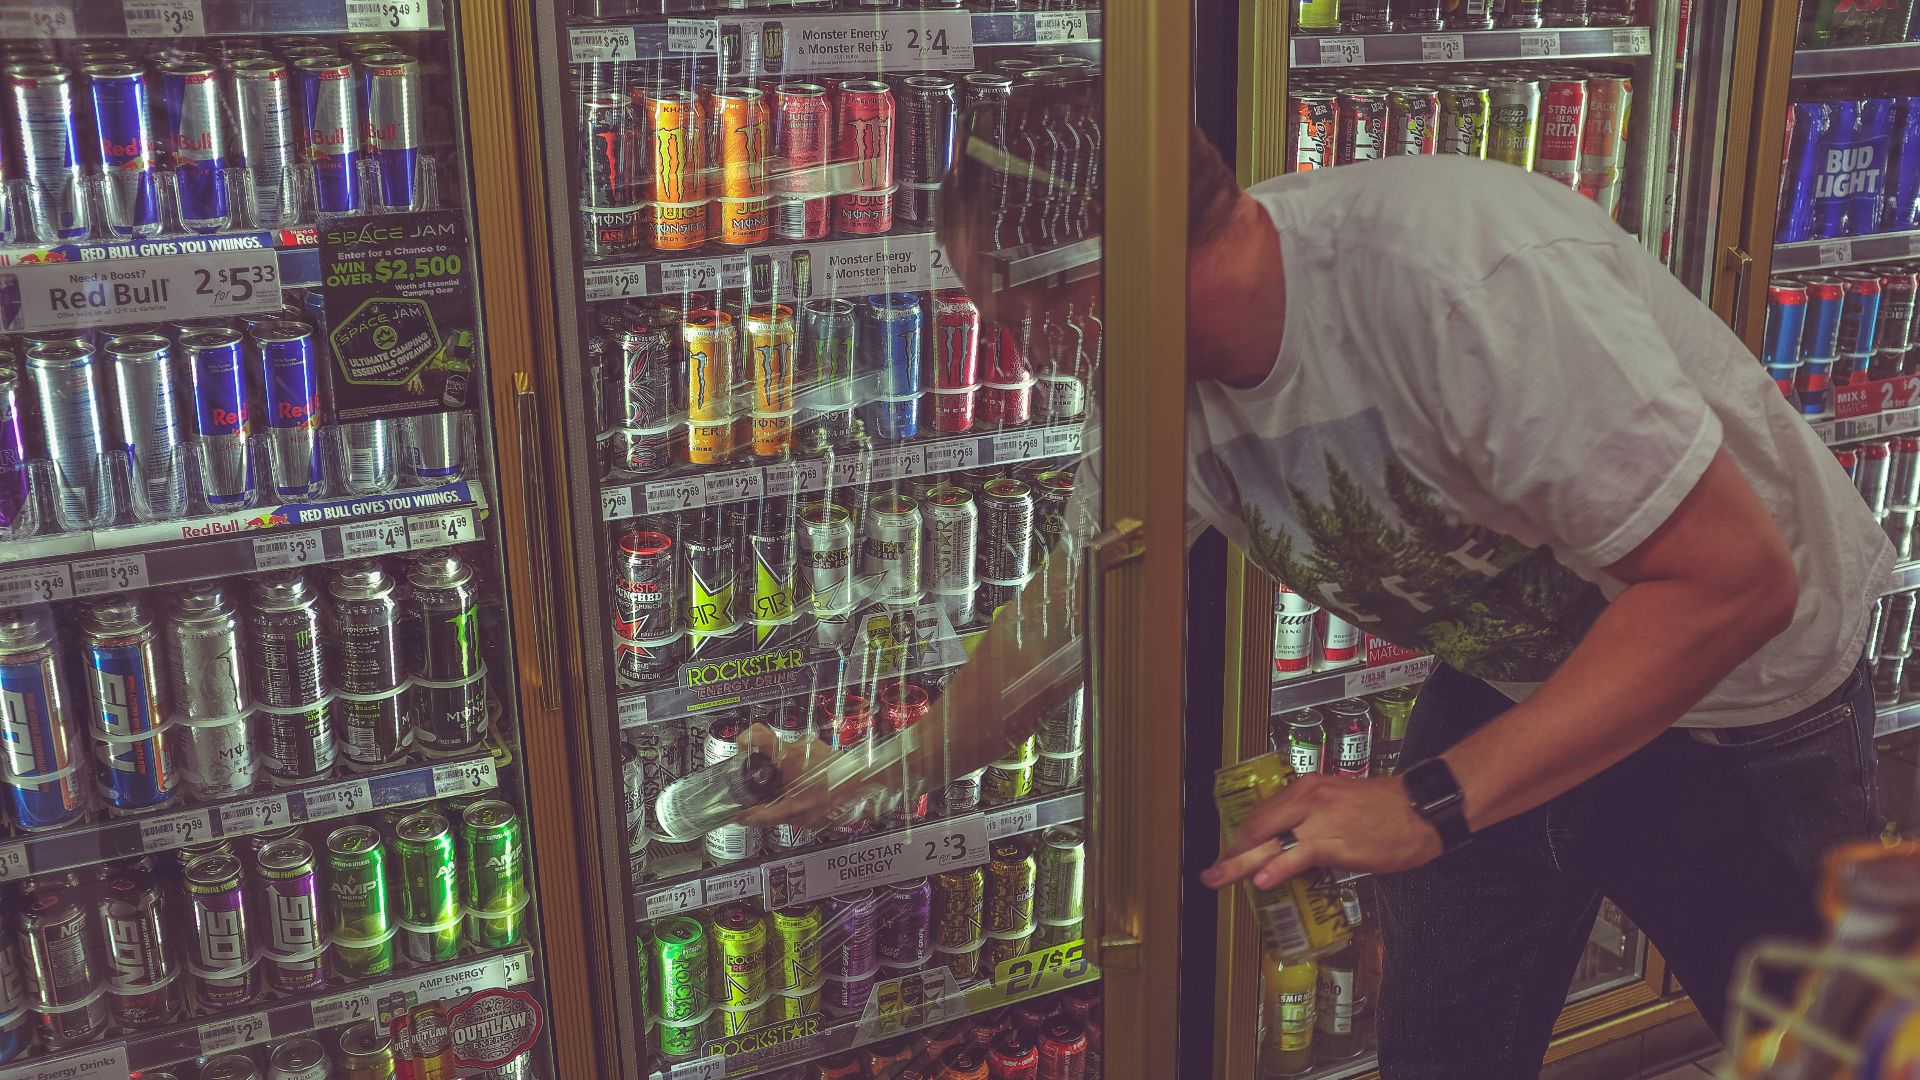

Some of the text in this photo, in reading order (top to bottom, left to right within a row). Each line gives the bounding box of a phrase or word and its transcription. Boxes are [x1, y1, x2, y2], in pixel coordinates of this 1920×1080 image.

[802, 29, 888, 44] Monster Energy
[807, 42, 857, 54] Monster
[858, 40, 893, 53] Rehab
[907, 29, 920, 49] 2
[1548, 105, 1581, 115] STRAW
[1545, 123, 1578, 137] RITA
[1827, 145, 1874, 174] BUD
[1815, 168, 1881, 199] LIGHT
[327, 223, 455, 246] SPACE JAM
[81, 249, 106, 262] RED
[109, 243, 140, 259] BULL
[142, 240, 178, 257] GIVES
[179, 239, 206, 254] YOU
[338, 251, 365, 261] Enter
[368, 250, 383, 259] for
[393, 246, 433, 256] Chance
[435, 244, 447, 252] to
[829, 250, 912, 267] Monster Energy
[69, 269, 146, 284] Need a Boost?
[331, 261, 365, 275] WIN
[374, 255, 461, 283] $2,500
[834, 266, 881, 280] Monster
[883, 264, 917, 276] Rehab
[194, 269, 214, 295] 2
[326, 273, 373, 287] OVER
[427, 279, 459, 288] Essential
[49, 278, 169, 311] Red Bull
[402, 287, 454, 298] Camping Gear
[339, 307, 421, 346] SPACE JAM
[348, 332, 429, 368] ULTIMATE CAMPING
[351, 339, 433, 378] ESSENTIALS GIVEAWAY
[1837, 391, 1859, 404] MIX
[1881, 382, 1894, 409] 2
[213, 403, 249, 426] Red
[299, 509, 323, 522] RED
[324, 504, 351, 519] BULL
[352, 501, 385, 515] GIVES
[385, 496, 411, 511] YOU
[182, 519, 240, 539] Red Bull
[687, 648, 804, 688] ROCKSTAR
[698, 679, 749, 699] ENERGY
[754, 671, 797, 688] DRINK
[485, 846, 523, 867] AMP
[828, 842, 903, 871] ROCKSTAR
[925, 842, 938, 860] 2
[840, 858, 893, 881] ENERGY
[331, 880, 377, 895] AMP
[419, 967, 487, 990] AMP ENERGY
[1005, 947, 1089, 999] 2/$3
[411, 1026, 449, 1045] OUTLAW
[454, 1012, 529, 1045] OUTLAW
[472, 1032, 517, 1050] ENERGY
[38, 1061, 79, 1080] Energy
[80, 1057, 116, 1072] Drinks
